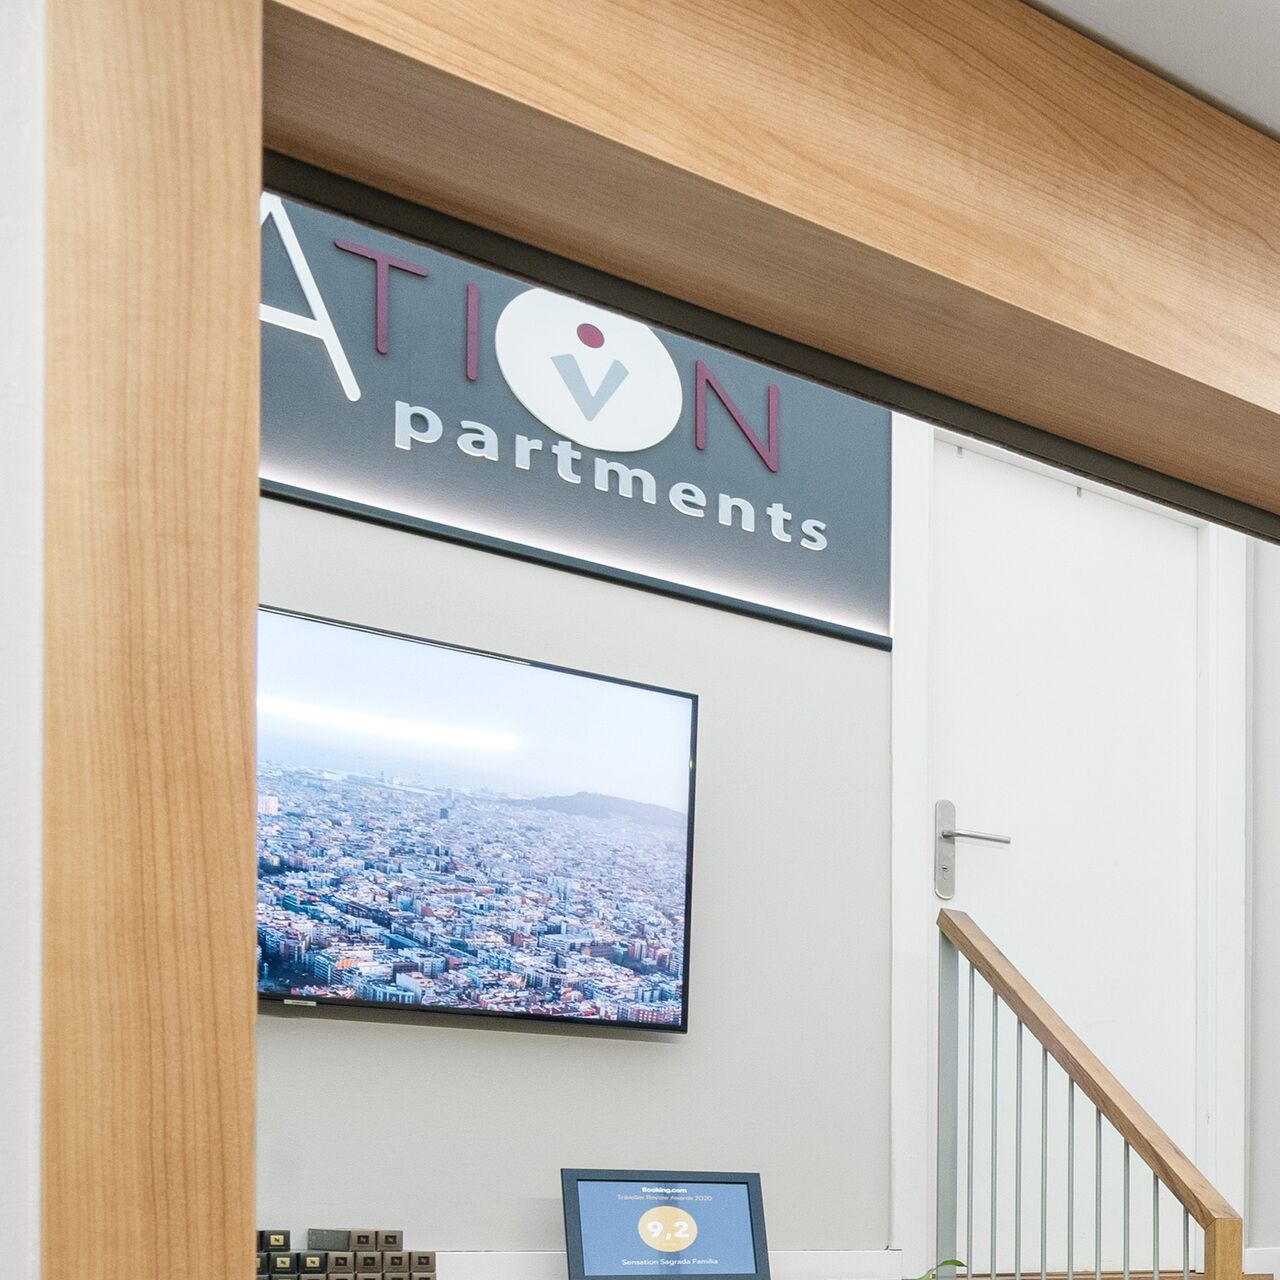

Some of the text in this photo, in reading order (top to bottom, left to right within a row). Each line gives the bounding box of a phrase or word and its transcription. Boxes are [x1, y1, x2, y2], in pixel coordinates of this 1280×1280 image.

[394, 400, 829, 552] partments
[641, 1186, 687, 1194] Booking.com
[647, 1221, 690, 1240] 9,2
